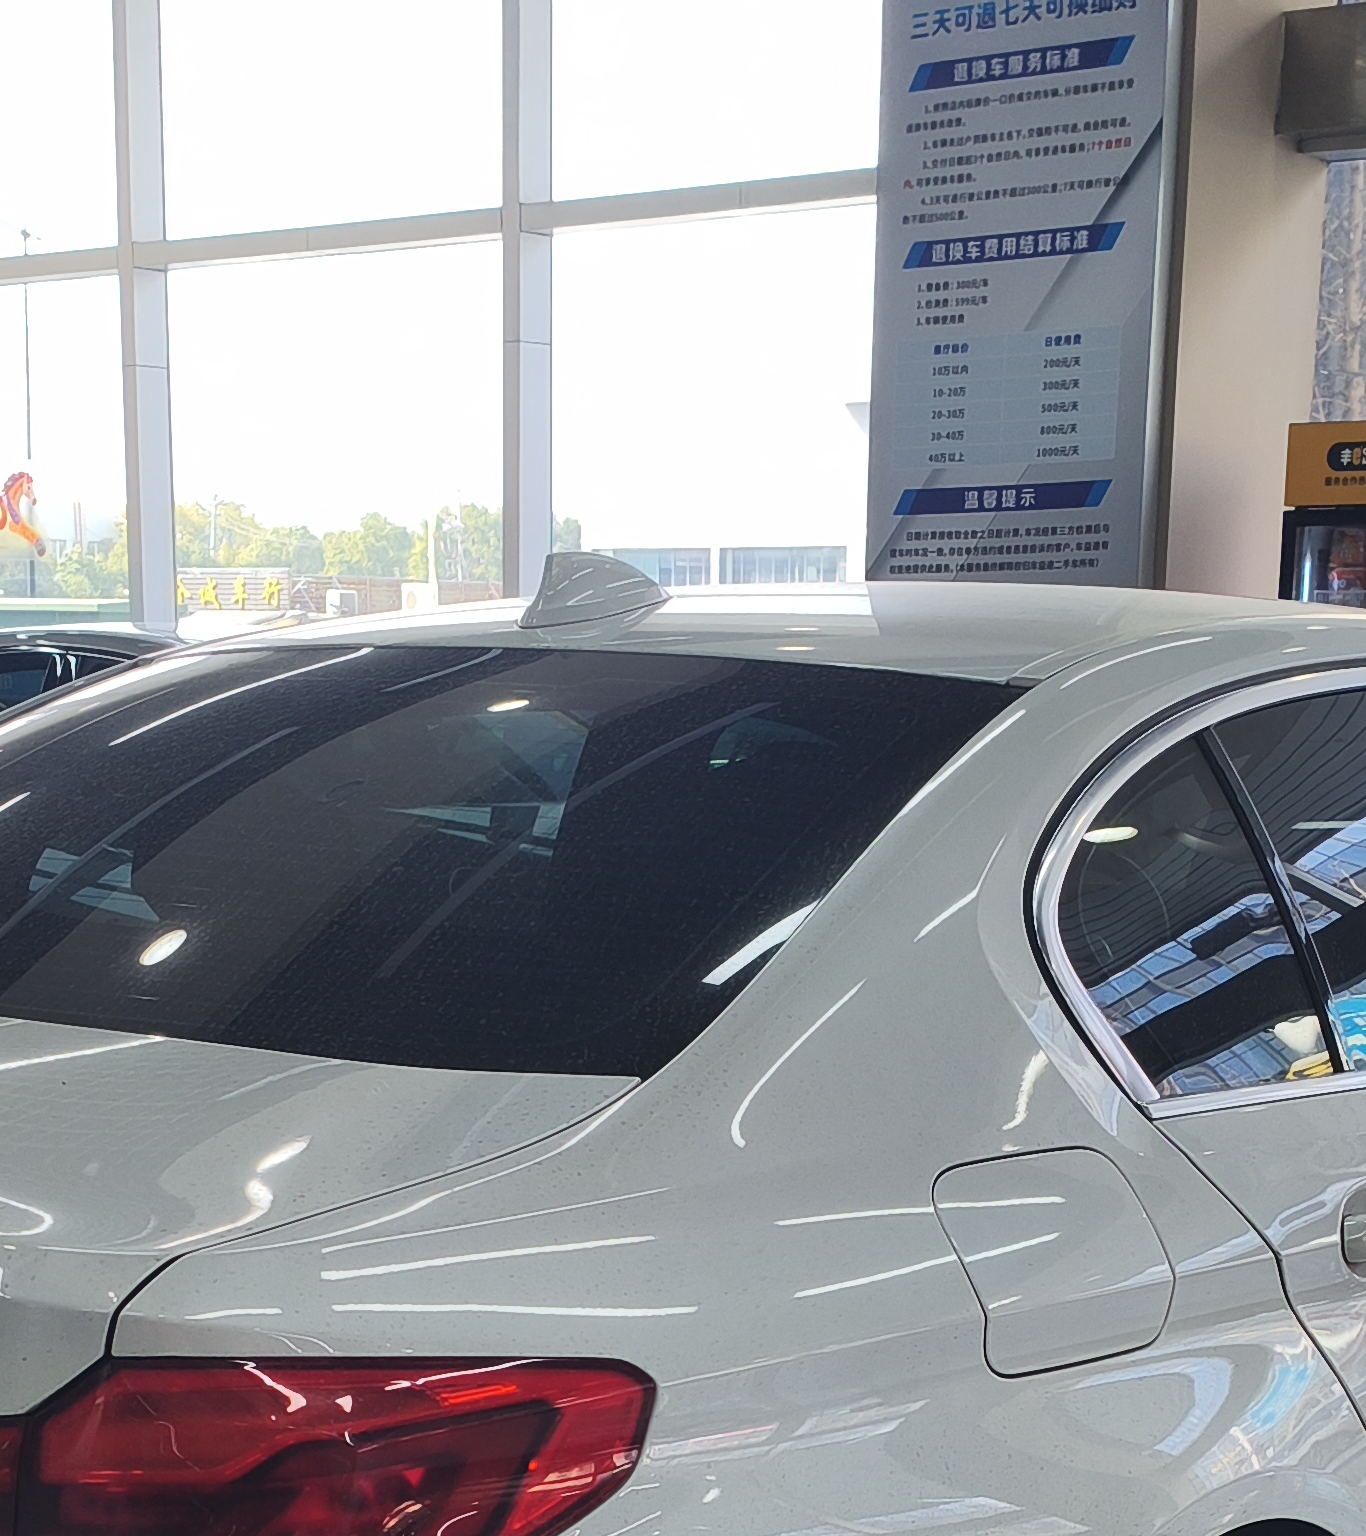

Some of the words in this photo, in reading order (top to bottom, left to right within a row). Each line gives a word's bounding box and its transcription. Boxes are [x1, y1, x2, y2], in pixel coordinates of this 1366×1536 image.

[931, 230, 1090, 263] 退换车费用结算标准
[964, 488, 1036, 510] 温馨提示
